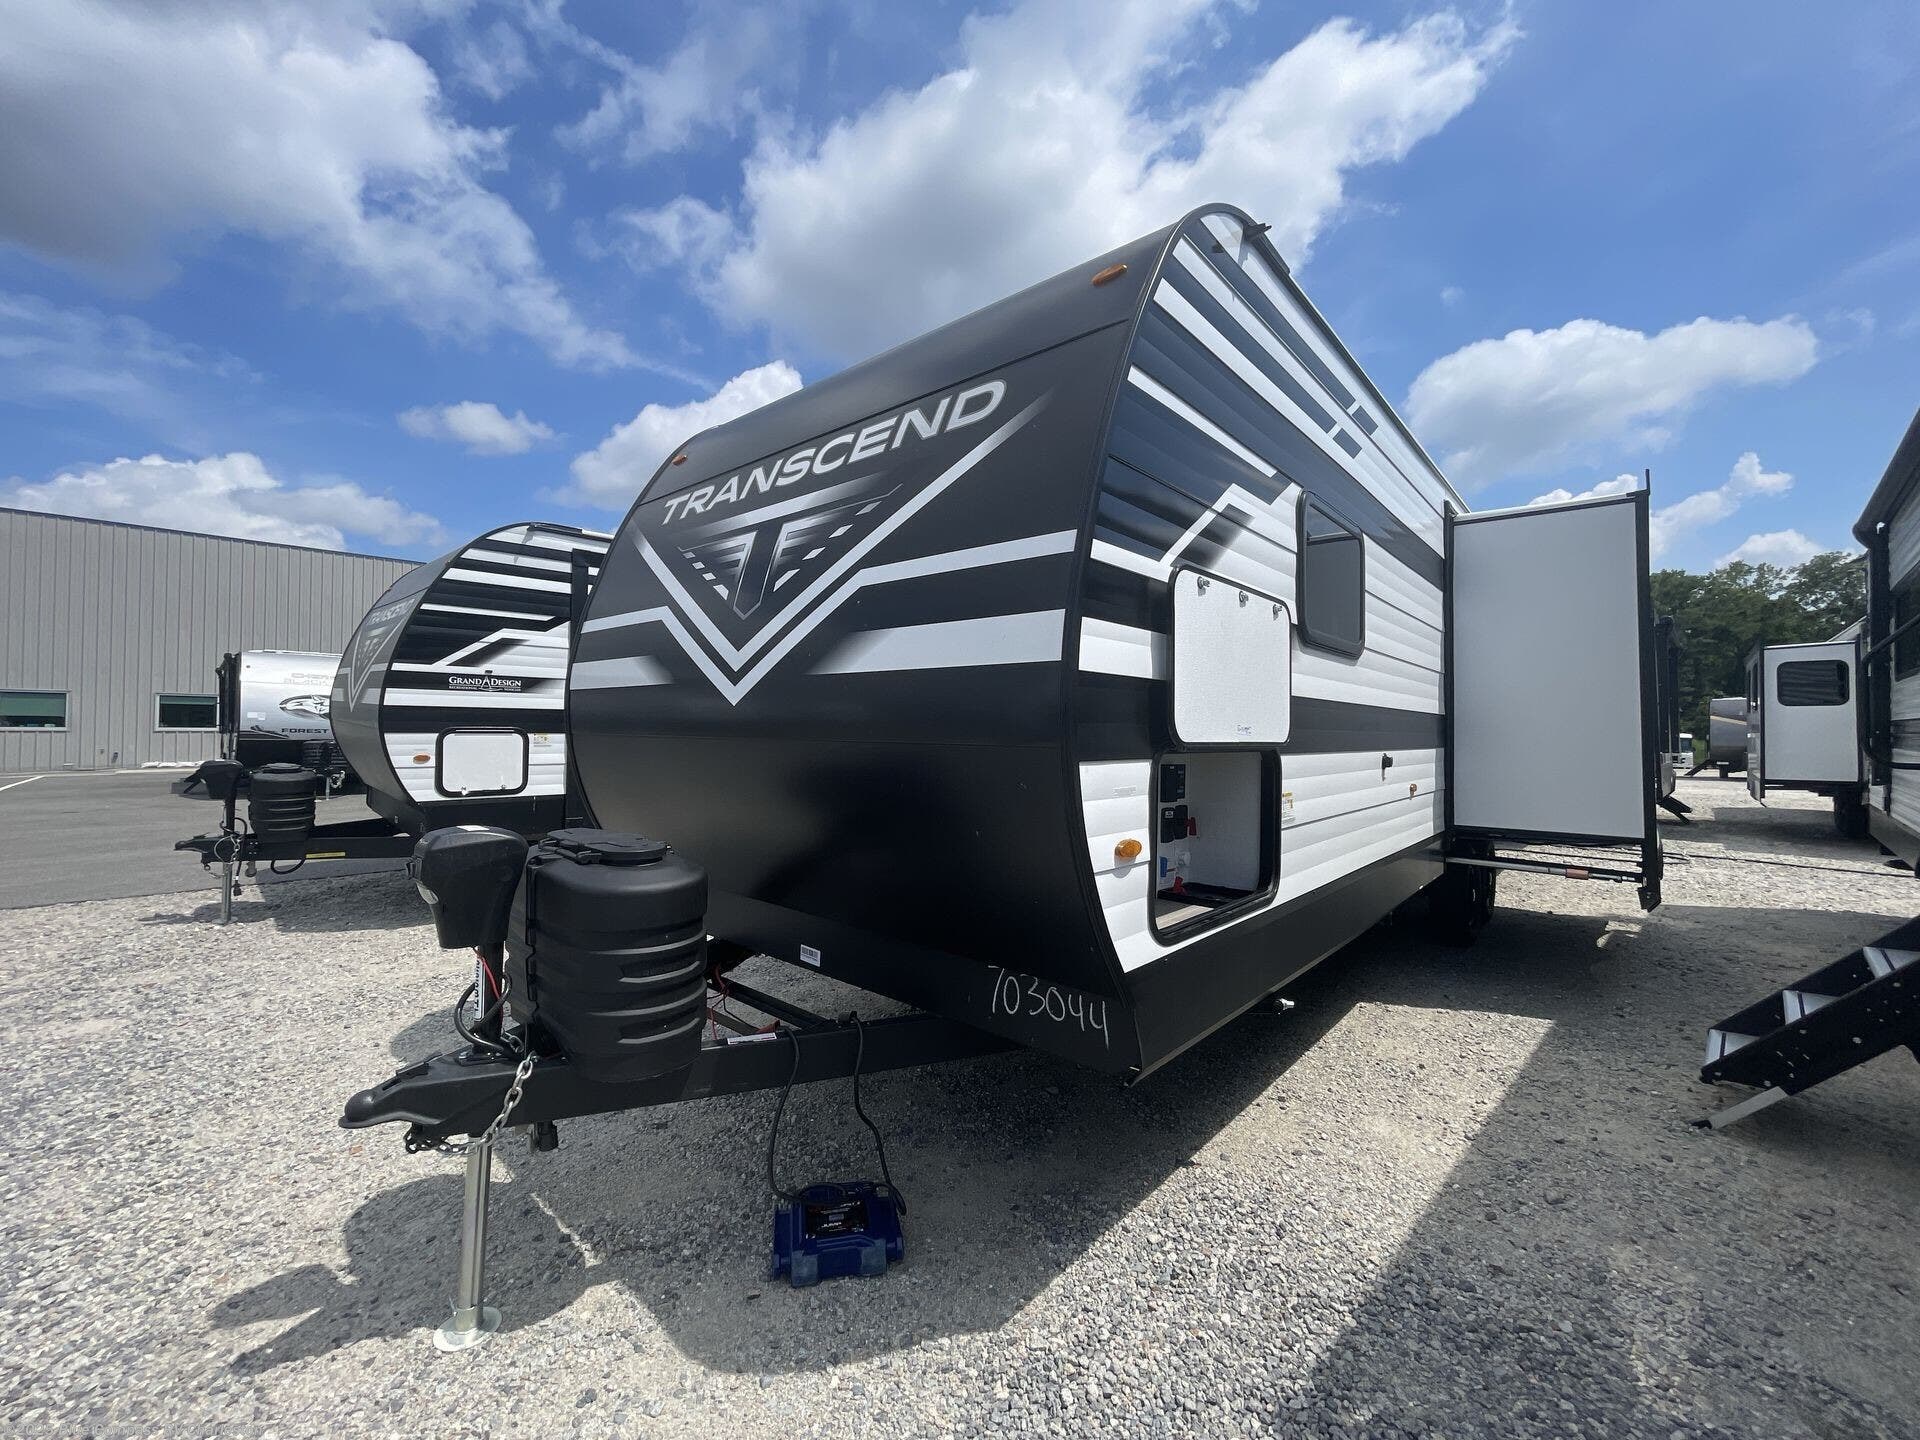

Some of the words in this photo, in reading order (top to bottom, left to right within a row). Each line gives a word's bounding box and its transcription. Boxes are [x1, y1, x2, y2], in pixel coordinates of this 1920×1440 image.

[662, 379, 1007, 525] TRANSCEND
[448, 676, 482, 685] GRAND
[490, 678, 522, 687] DESIGN
[281, 727, 330, 735] FOREST
[987, 964, 1109, 1049] 703044
